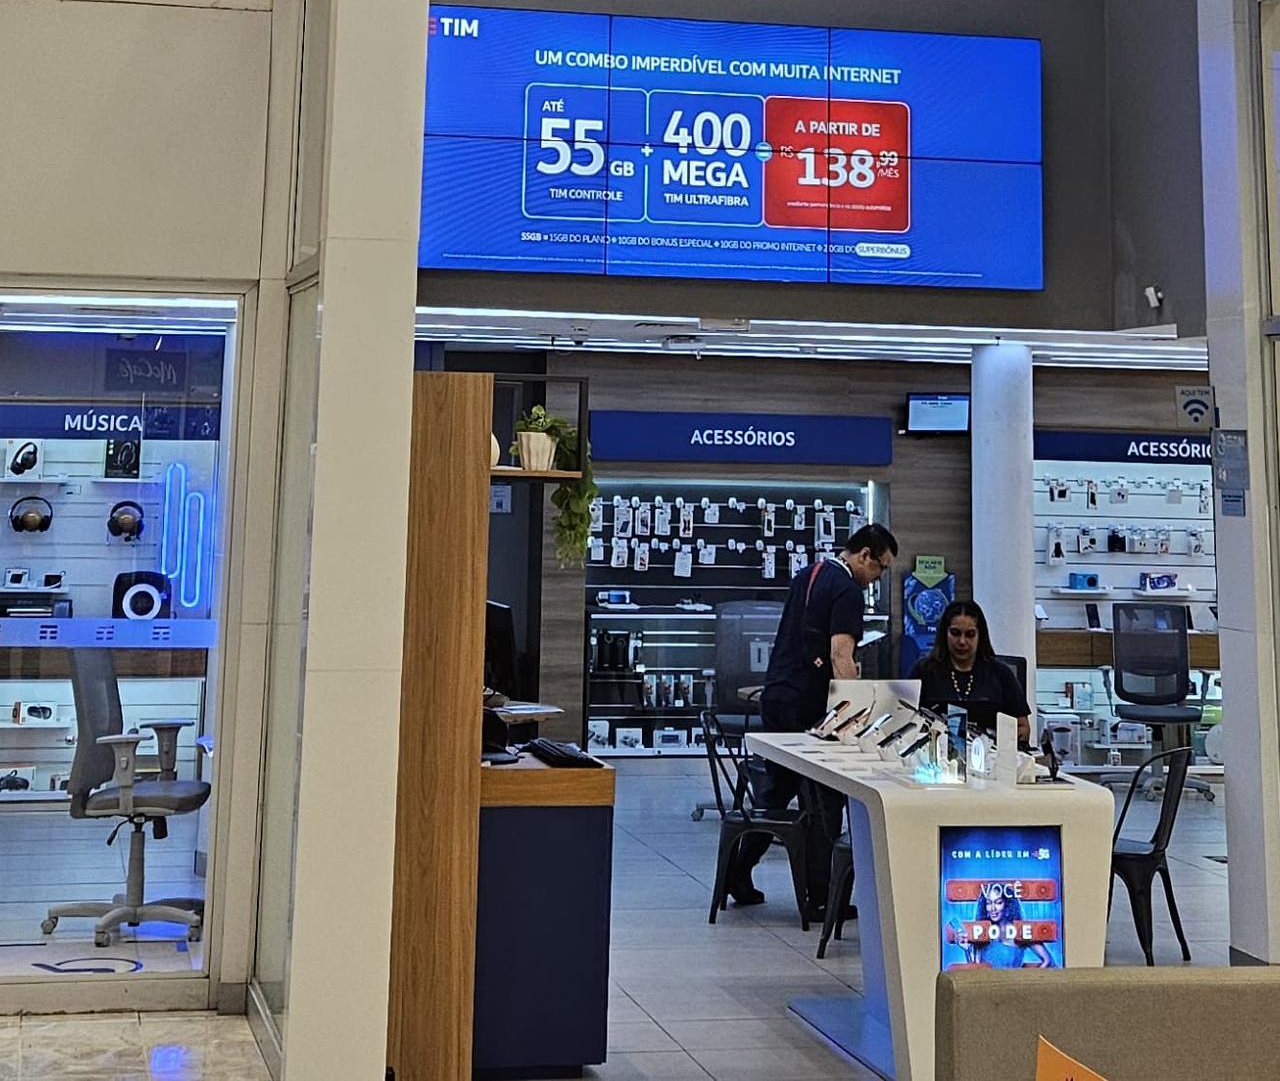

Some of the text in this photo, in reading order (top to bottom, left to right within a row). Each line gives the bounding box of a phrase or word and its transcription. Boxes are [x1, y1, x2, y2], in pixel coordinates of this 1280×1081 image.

[440, 17, 479, 37] TIM
[535, 50, 901, 84] UM COMBO IMPERDÍVEL COM MUITA INTERNET
[542, 99, 564, 112] ATÉ
[663, 110, 751, 157] 400
[795, 120, 880, 136] A PARTIR DE
[536, 117, 635, 177] 55 GB
[663, 159, 749, 188] MEGA
[780, 146, 794, 158] R$
[796, 147, 875, 188] 138
[549, 188, 623, 201] TIM CONTROLE
[664, 193, 749, 206] TIM ULTRAFIBRA
[570, 234, 581, 242] DO
[582, 234, 610, 243] PLANO
[638, 237, 650, 246] DO
[679, 238, 713, 248] ESPECIAL
[740, 241, 751, 249] DO
[753, 241, 780, 250] PROMO
[781, 242, 816, 252] INTERNET
[64, 409, 143, 432] MÚSICA
[691, 426, 796, 446] ACESSÓRIOS
[951, 850, 971, 859] COM
[985, 849, 1013, 859] LÍDER
[1017, 850, 1029, 858] EM
[1037, 848, 1050, 860] 5G
[980, 881, 1023, 899] VOCÊ
[972, 924, 1033, 940] PODE
